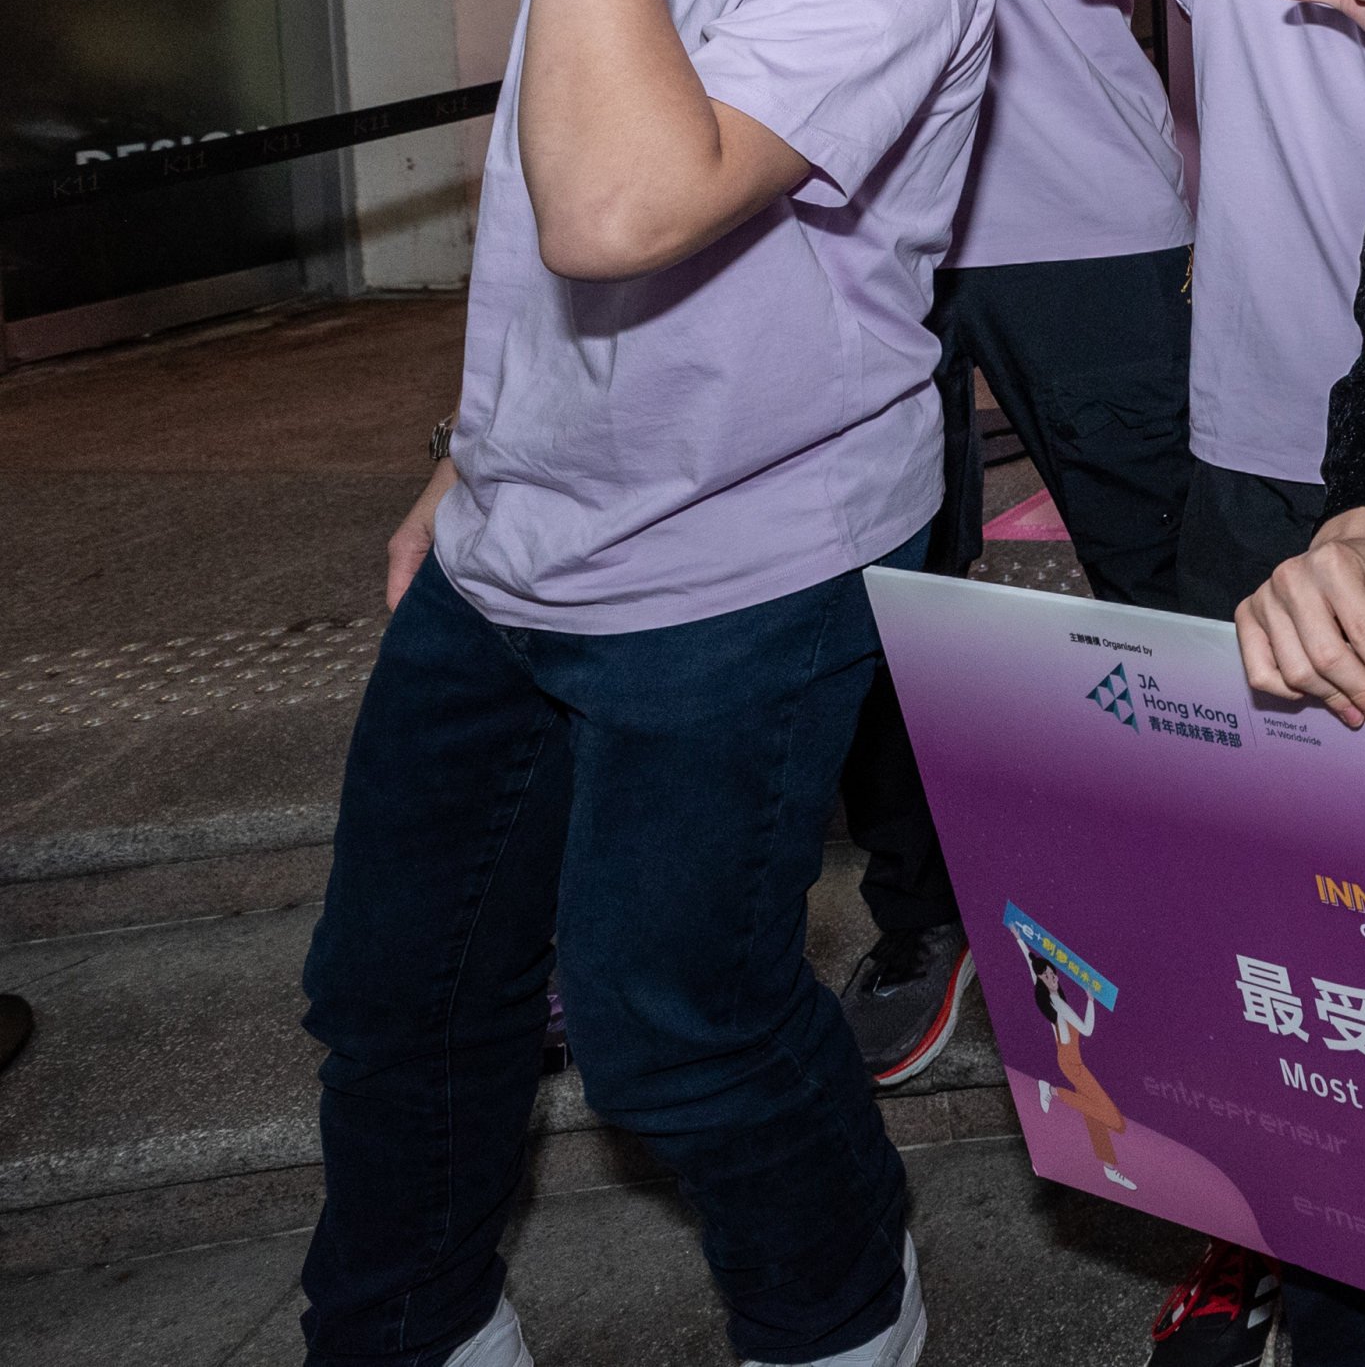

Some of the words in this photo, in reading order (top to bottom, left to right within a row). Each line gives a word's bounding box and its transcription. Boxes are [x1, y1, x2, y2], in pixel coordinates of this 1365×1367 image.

[1102, 638, 1141, 653] Organised
[1142, 646, 1152, 656] by
[1139, 673, 1159, 692] JA
[1144, 694, 1189, 720] Hong
[1193, 703, 1238, 729] Kong
[1148, 716, 1242, 748] 青年成就香港部
[1263, 717, 1296, 731] Member
[1297, 723, 1308, 734] of
[1265, 726, 1275, 737] JA
[1276, 729, 1322, 747] Worldwide
[1280, 1058, 1362, 1110] Most
